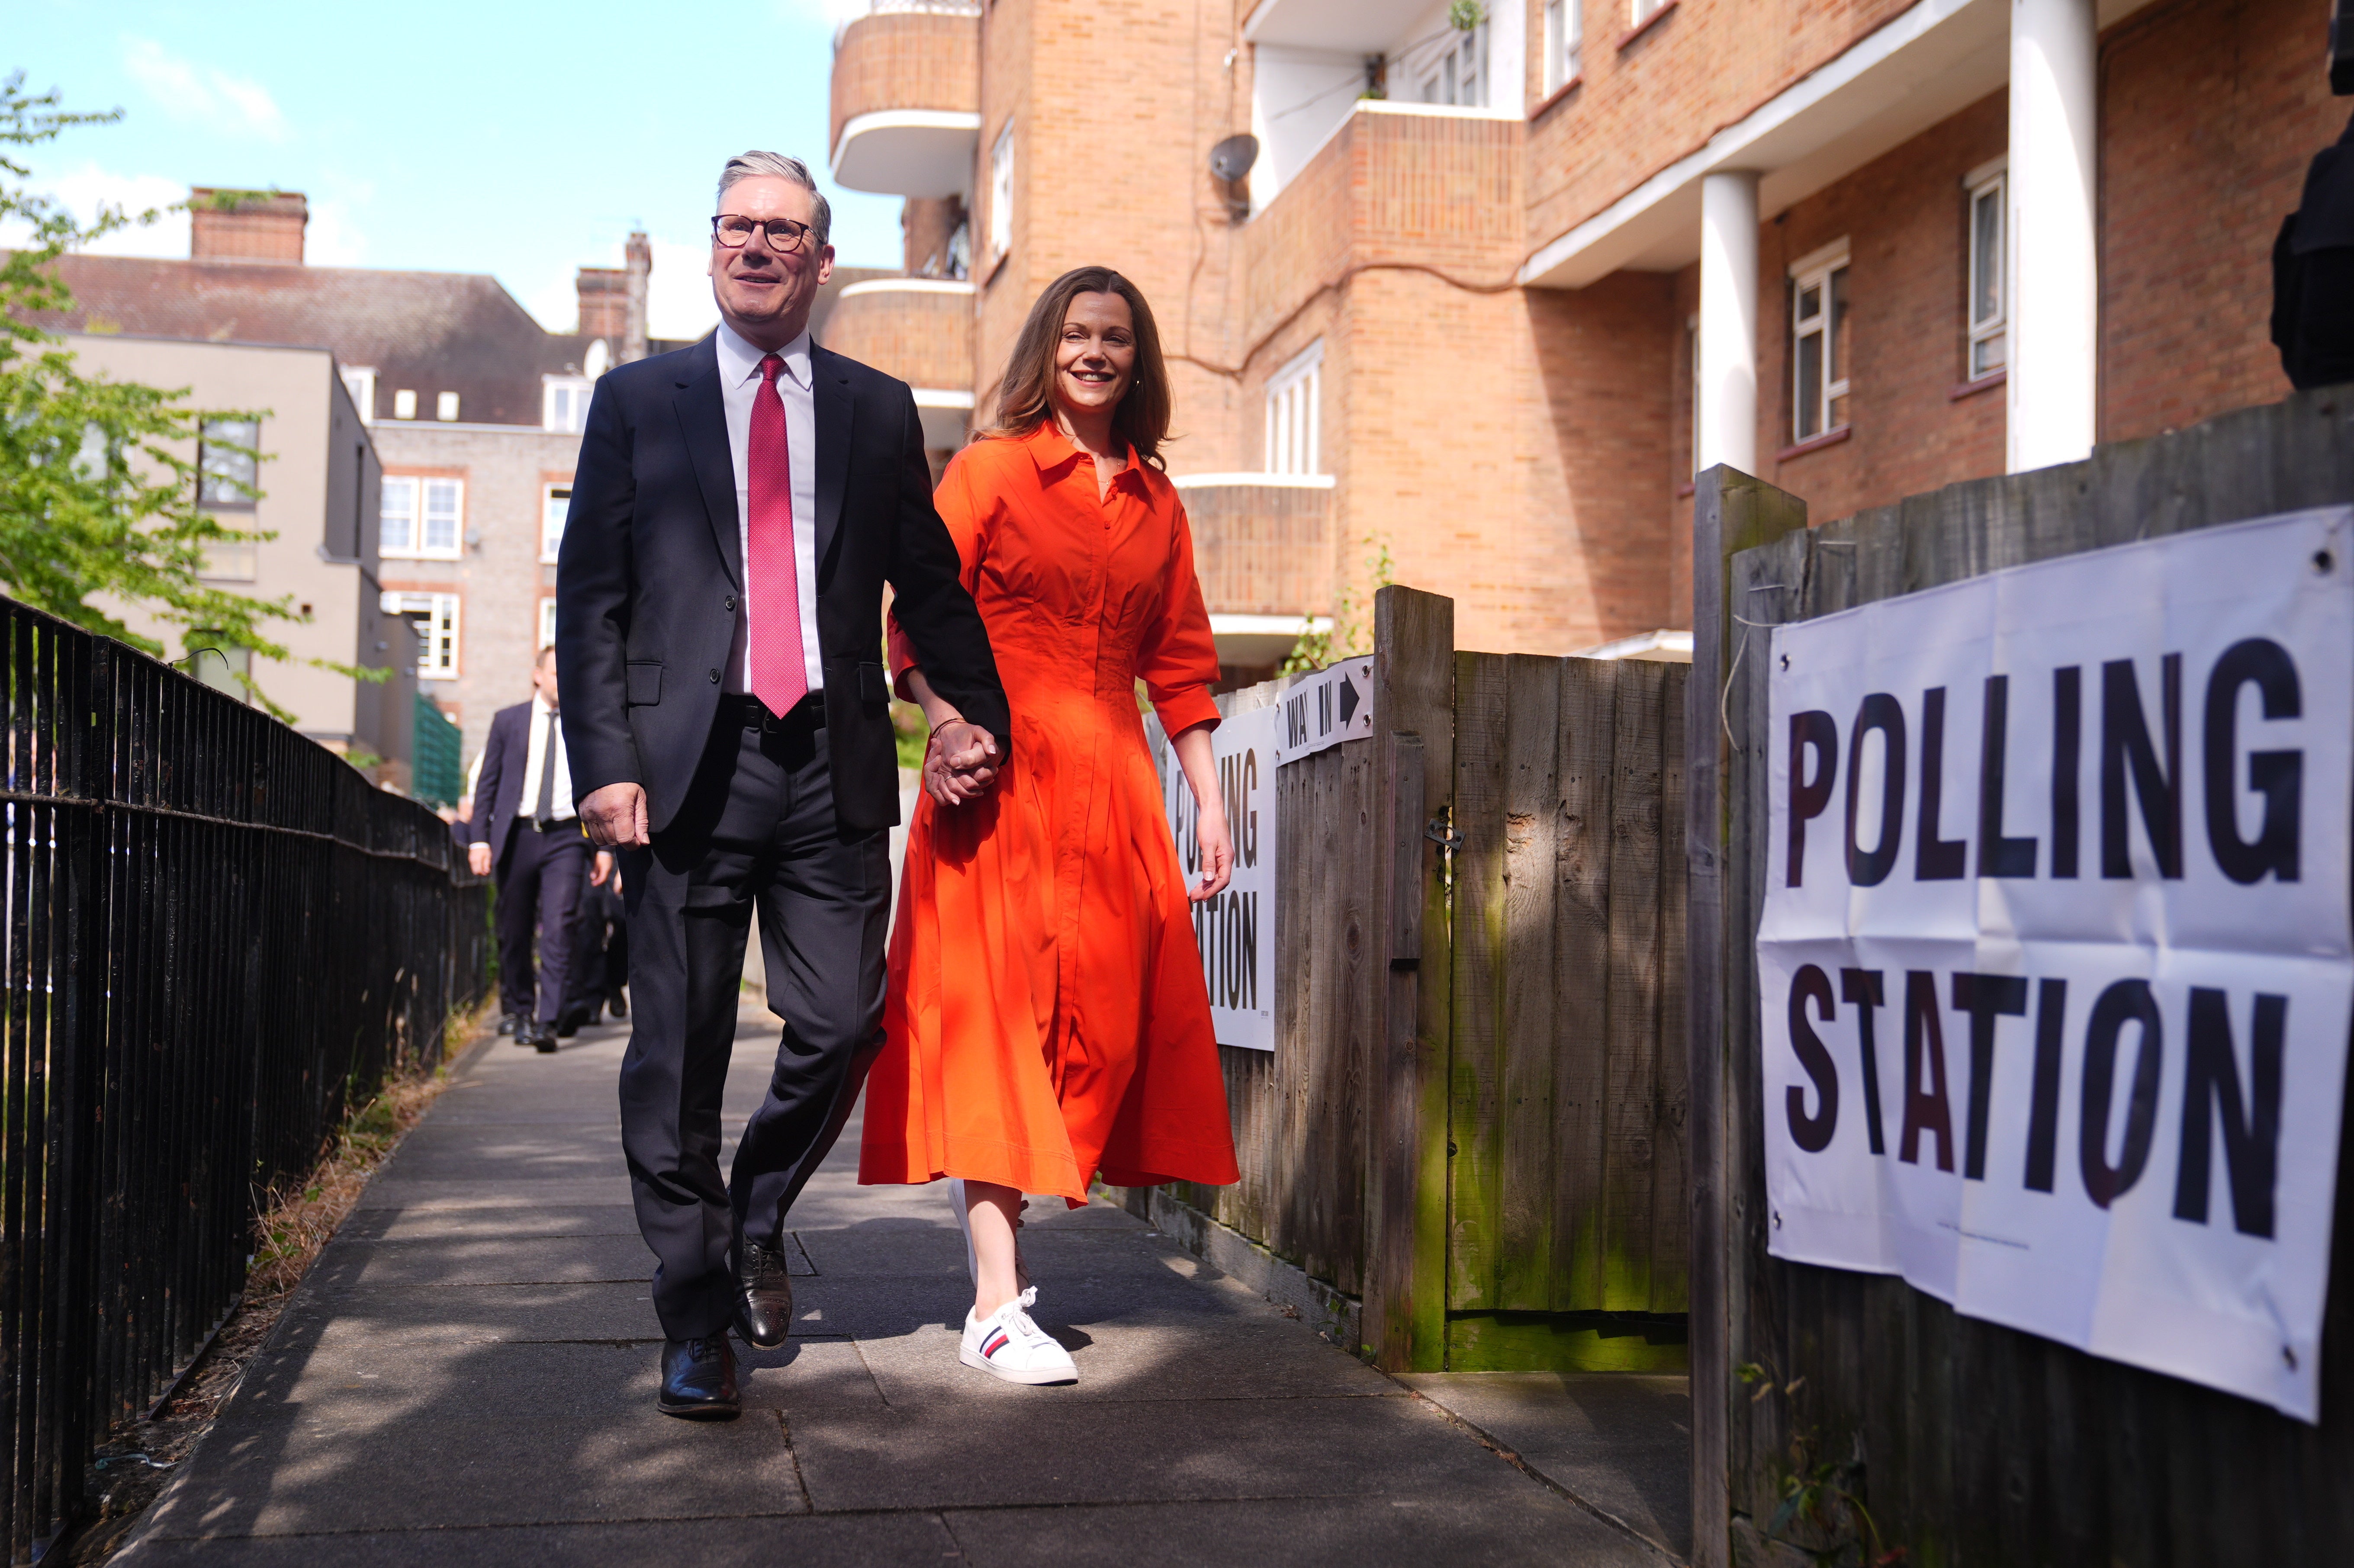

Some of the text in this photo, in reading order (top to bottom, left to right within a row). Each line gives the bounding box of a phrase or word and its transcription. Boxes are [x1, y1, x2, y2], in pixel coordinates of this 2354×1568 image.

[1287, 680, 1331, 749] WA IN
[1786, 637, 2303, 888] POLLING
[1176, 748, 1257, 875] PONG
[1188, 890, 1257, 1010] TION
[1786, 964, 2288, 1242] STATION
